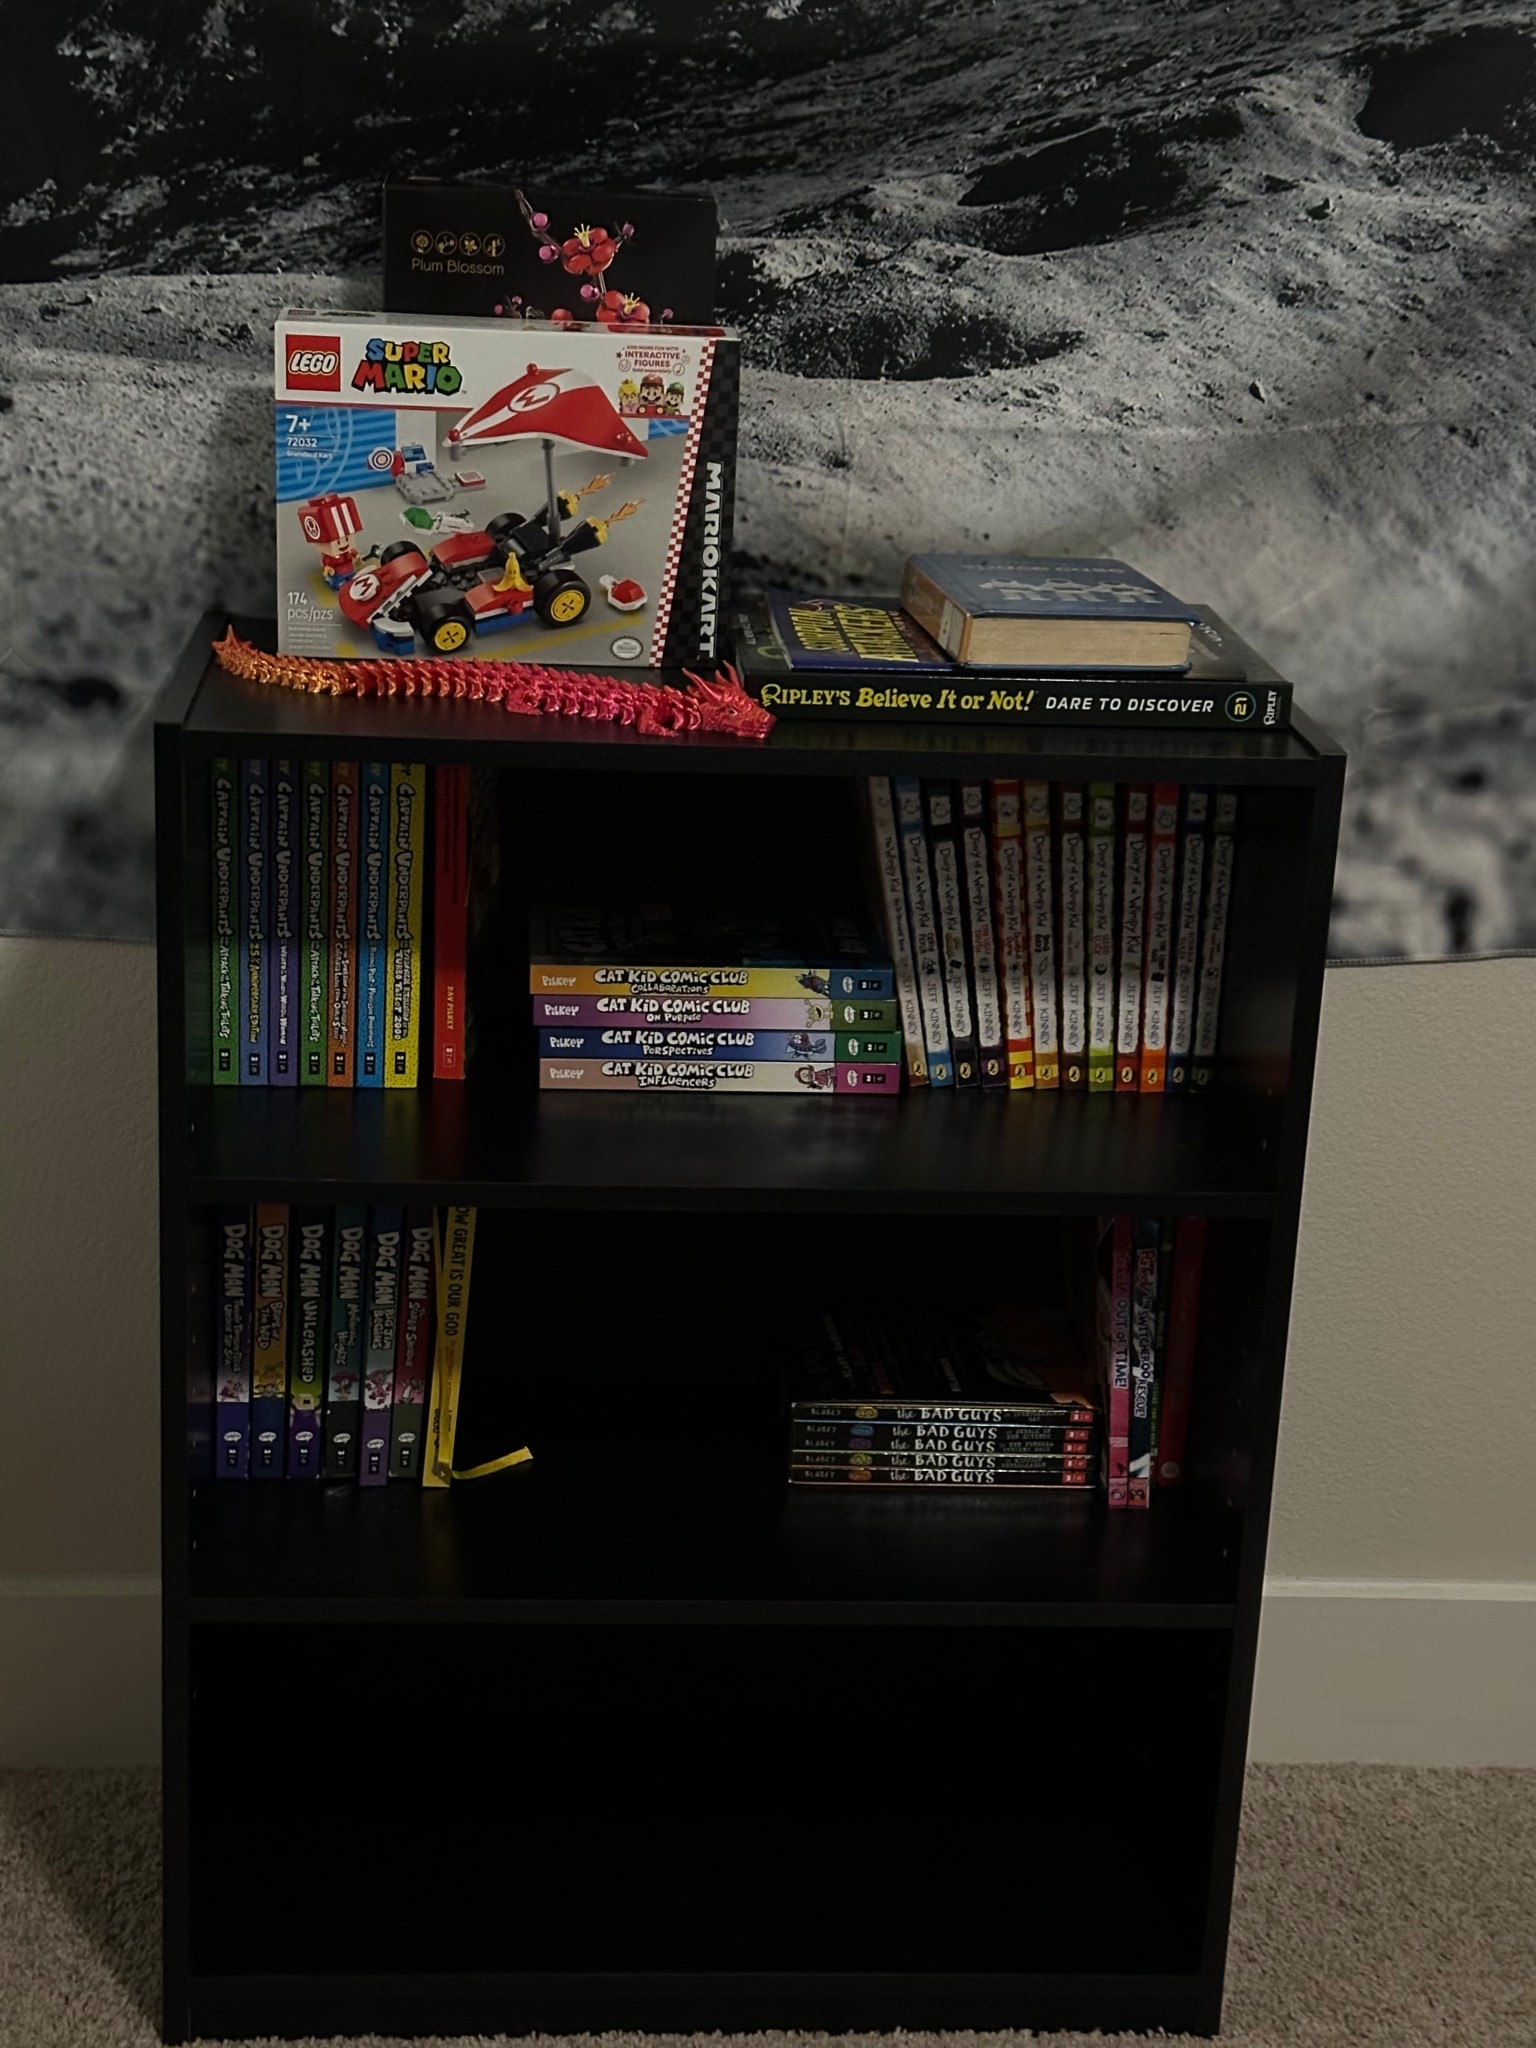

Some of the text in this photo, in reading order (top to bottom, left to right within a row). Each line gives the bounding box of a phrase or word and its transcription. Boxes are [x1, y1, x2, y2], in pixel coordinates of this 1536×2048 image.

[411, 258, 504, 275] Plum Blossom
[289, 352, 338, 375] LEGO
[366, 338, 450, 363] SUPER
[625, 351, 680, 360] INTERACTIVE
[634, 360, 671, 368] FIGURES
[351, 359, 463, 396] MARIO
[285, 414, 311, 433] 7+
[286, 437, 318, 448] 72032
[286, 450, 317, 459] Standard
[287, 592, 308, 605] 174
[287, 606, 333, 622] pcs/pzs
[760, 683, 1035, 711] RIPLEY'S Believe It or Not!
[1045, 696, 1214, 713] DARE TO DISCOVER
[1263, 689, 1278, 725] RIPLEY
[215, 778, 233, 845] CAPTAIN
[247, 783, 265, 849] CAPTAIN
[276, 781, 294, 848] CAPTAIN
[307, 783, 325, 849] CAPTAIN
[335, 783, 354, 849] CAPTAIN
[367, 783, 385, 849] CAPTAIN
[396, 783, 416, 849] CAPTAIN
[909, 837, 922, 864] Diary
[1033, 835, 1045, 862] Diary
[1129, 838, 1145, 872] Diary
[215, 846, 235, 935] UNDERPANTS
[247, 851, 265, 940] UNDERPANTS
[275, 849, 294, 938] UNDERPANTS
[307, 850, 325, 940] UNDERPANTS
[334, 851, 353, 940] UNDERPANTS
[365, 851, 384, 940] UNDERPANTS
[395, 850, 414, 940] UNDERPANTS
[1034, 880, 1047, 910] Wimpy
[1133, 876, 1141, 887] of
[915, 881, 926, 911] Wimpy
[919, 912, 930, 928] Kid
[1037, 912, 1048, 927] Kid
[1127, 896, 1142, 933] Wimpy
[1034, 933, 1043, 953] DAYS
[1042, 934, 1050, 952] DOG
[1127, 936, 1141, 953] Kid
[594, 969, 622, 983] CAT
[709, 970, 749, 985] CLUB
[446, 1003, 454, 1030] PILKEY
[596, 997, 627, 1013] CAT
[712, 999, 751, 1014] CLUB
[646, 1013, 662, 1023] ON
[927, 981, 942, 1045] JEFF KINNEY
[1039, 980, 1050, 1046] JEFF KINNEY
[1124, 983, 1136, 1048] JEFF KINNEY
[393, 1015, 402, 1041] 2000
[601, 1030, 632, 1045] CAT
[716, 1032, 755, 1047] CLUB
[643, 1045, 713, 1057] PERSPECTIVES
[601, 1061, 632, 1076] CAT
[716, 1064, 755, 1078] CLUB
[638, 1077, 716, 1088] INFLUENCERS
[299, 1223, 325, 1260] DOG
[223, 1223, 248, 1297] DOG MAN
[259, 1224, 286, 1298] DOG MAN
[338, 1225, 364, 1300] DOG MAN
[374, 1231, 400, 1305] DOG MAN
[408, 1226, 433, 1299] DOG MAN
[445, 1206, 471, 1336] OW GREAT IS OUR GOD
[300, 1262, 321, 1297] MAN
[383, 1308, 395, 1327] BIG
[1116, 1299, 1128, 1327] OUT
[1138, 1311, 1151, 1379] SWITCHEROO
[1115, 1348, 1128, 1387] TIME!
[1135, 1379, 1147, 1417] RESCUE!
[897, 1408, 918, 1420] the
[920, 1408, 954, 1420] BAD
[957, 1409, 1003, 1422] GUYS
[890, 1438, 996, 1453] the BAD GUYS
[892, 1425, 998, 1440] the BAD GUYS
[891, 1455, 911, 1466] the
[914, 1455, 948, 1467] BAD
[952, 1456, 997, 1468] GUYS
[890, 1470, 995, 1484] the BAD GUYS
